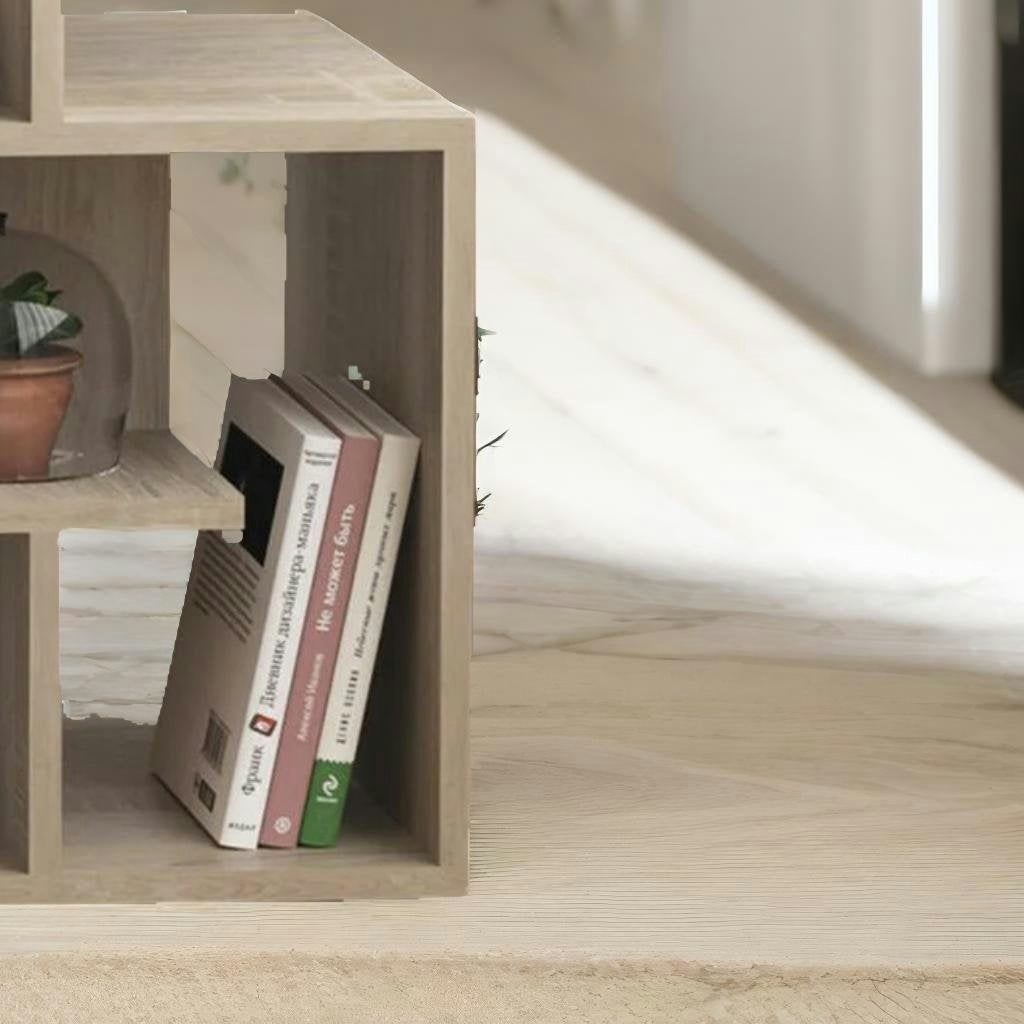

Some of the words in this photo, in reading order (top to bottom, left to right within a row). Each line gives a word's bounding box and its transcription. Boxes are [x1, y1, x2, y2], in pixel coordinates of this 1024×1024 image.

[334, 504, 356, 547] быть
[324, 550, 346, 606] может
[316, 609, 334, 632] Не
[241, 744, 265, 797] Франк
[259, 639, 286, 708] Дневник
